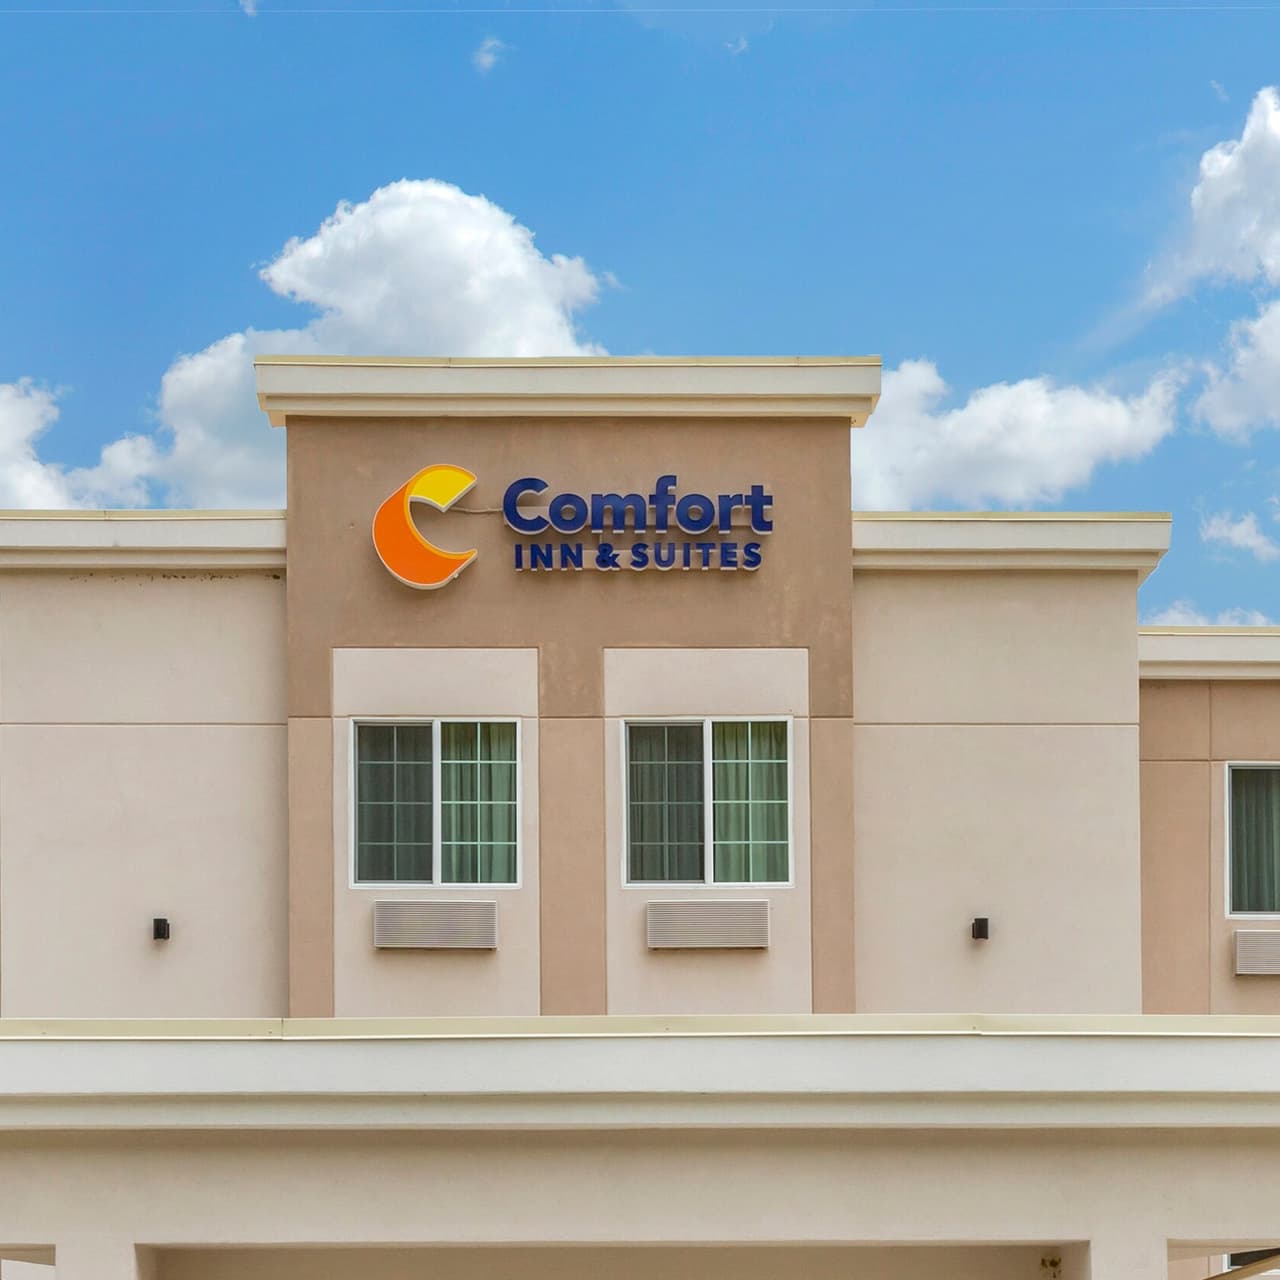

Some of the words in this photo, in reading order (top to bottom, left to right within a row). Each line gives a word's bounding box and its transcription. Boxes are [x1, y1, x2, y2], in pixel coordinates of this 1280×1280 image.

[503, 475, 773, 535] Comfort
[514, 544, 584, 571] INN
[595, 543, 620, 571] &
[630, 542, 763, 571] SUITES
